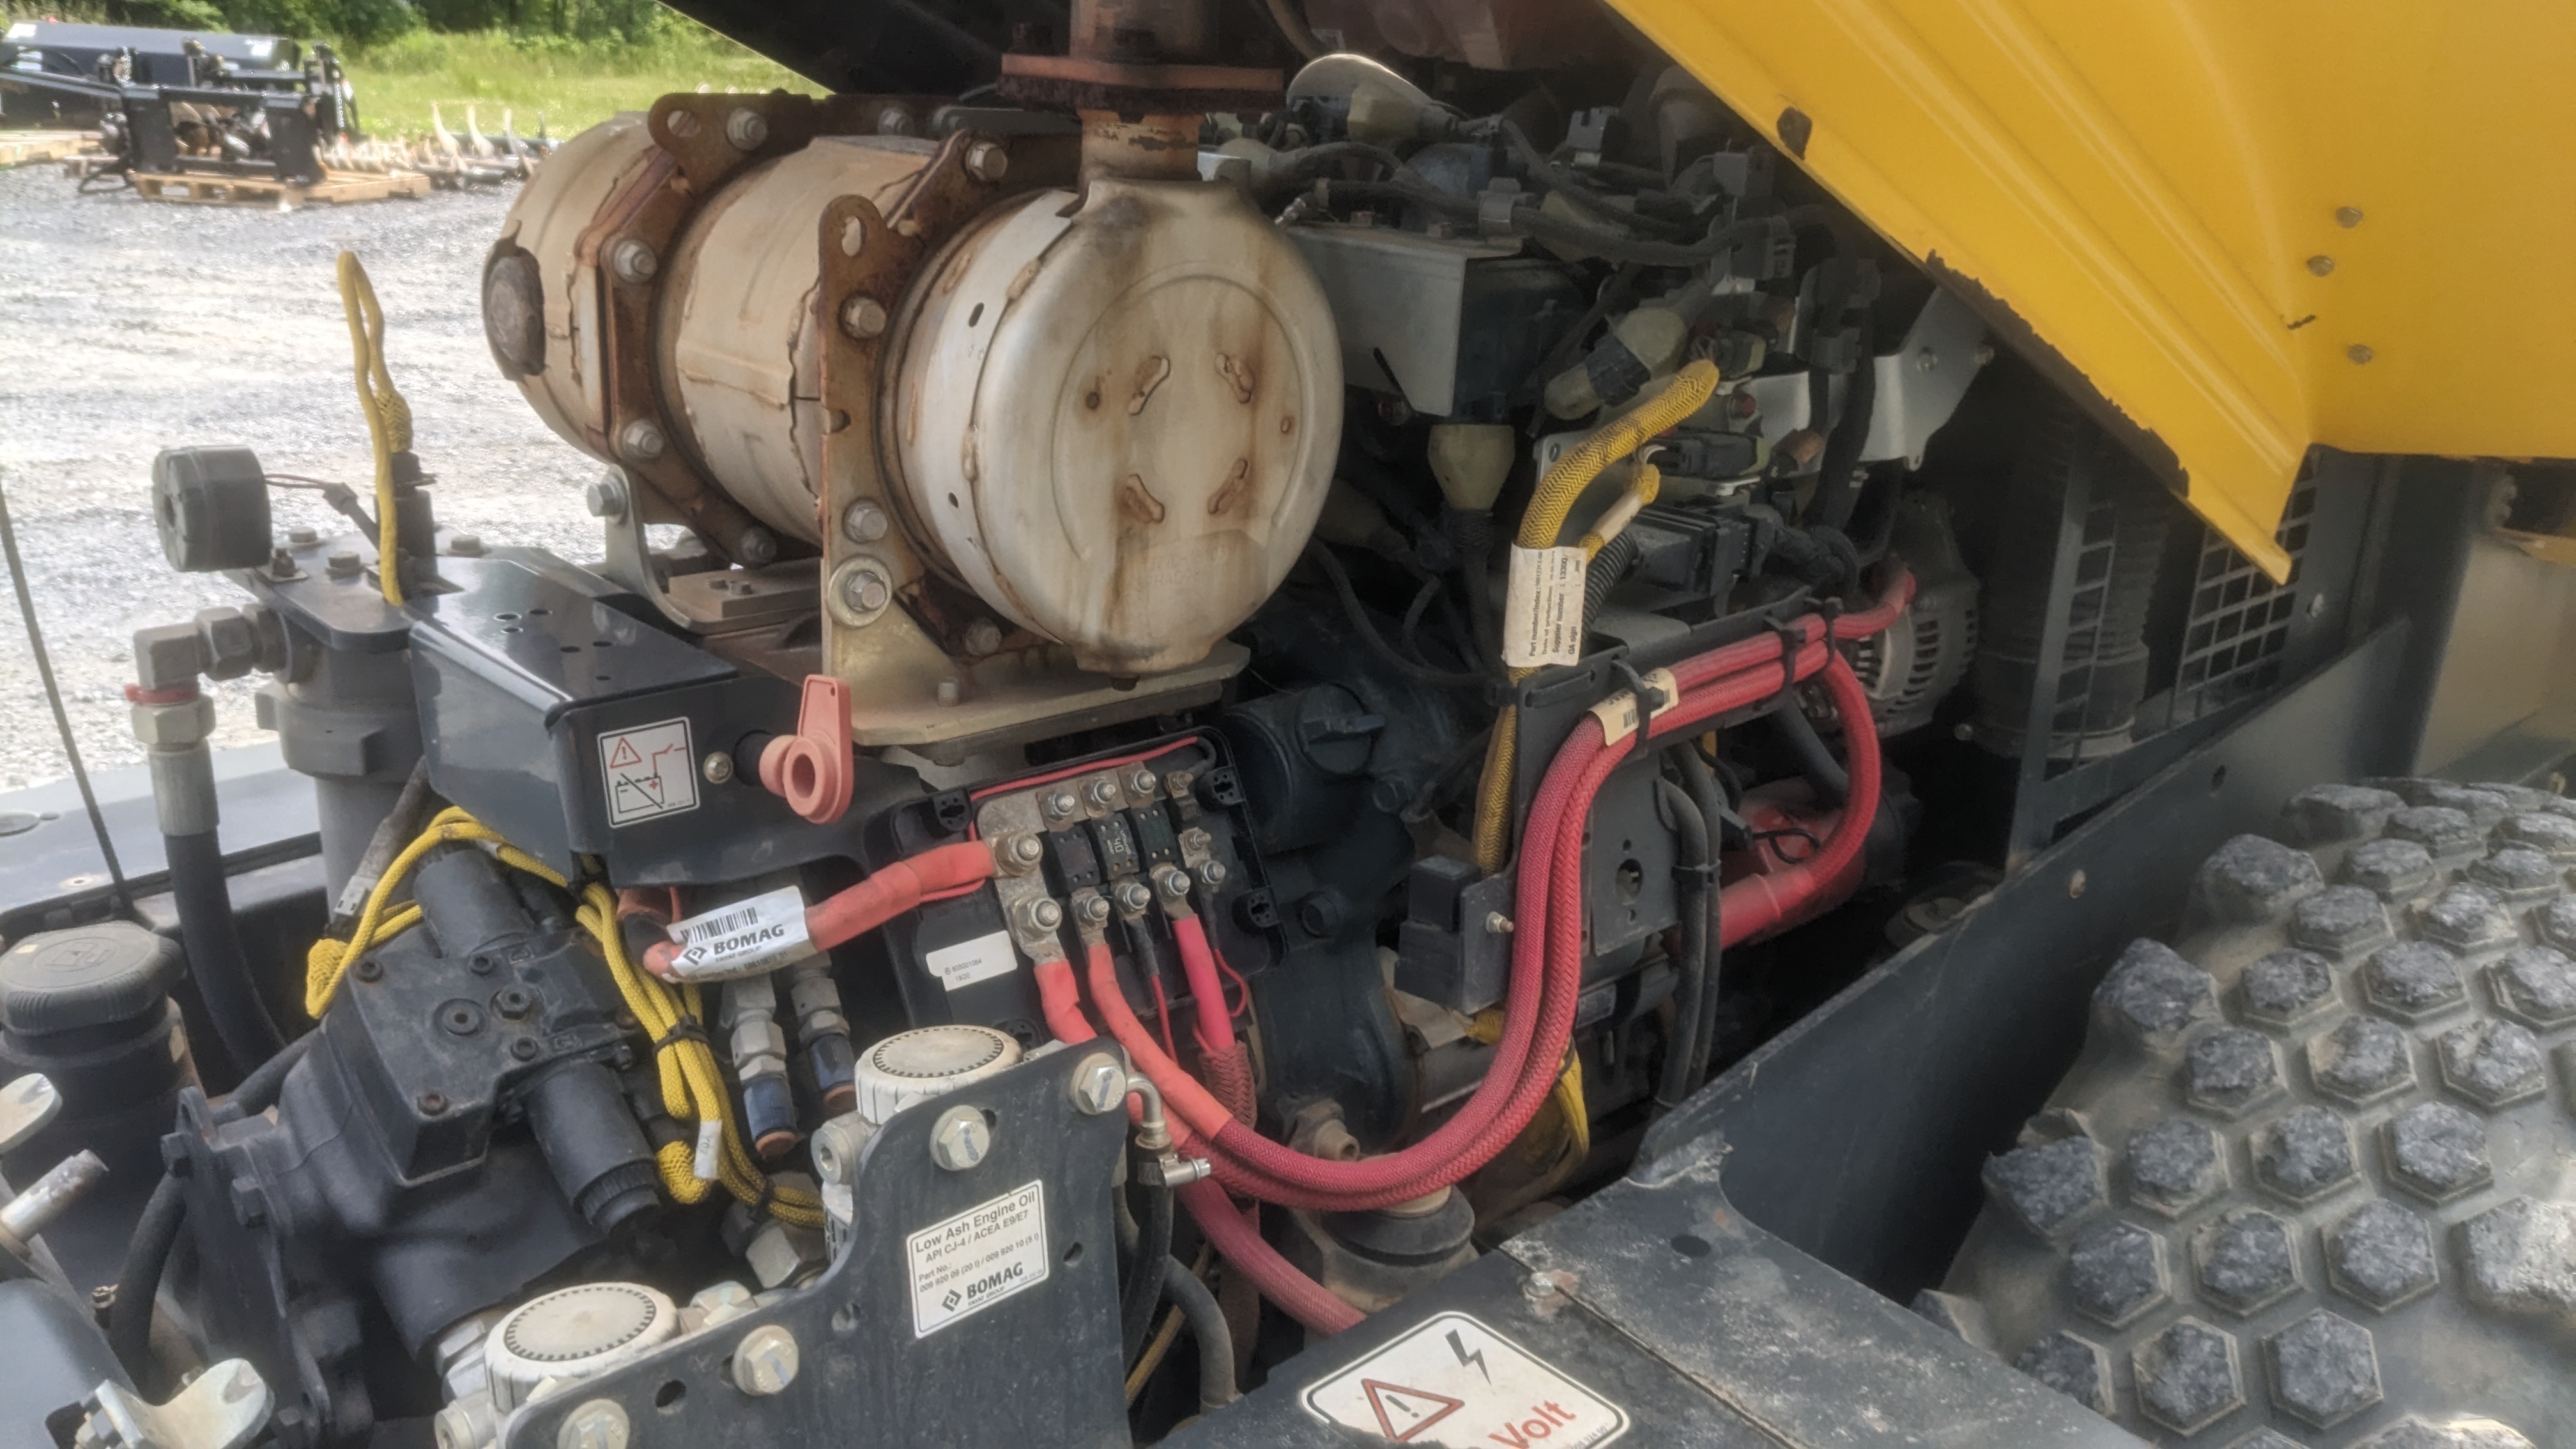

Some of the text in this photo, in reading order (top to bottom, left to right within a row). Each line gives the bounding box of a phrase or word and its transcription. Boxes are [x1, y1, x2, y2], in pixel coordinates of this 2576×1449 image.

[1556, 593, 1564, 621] number
[1552, 624, 1561, 652] Supplier
[1569, 626, 1577, 641] sign
[1568, 644, 1575, 654] QA
[1113, 838, 1124, 853] 40
[714, 924, 785, 954] BOMAG
[738, 946, 762, 957] GROUP
[916, 1191, 1034, 1253] Low Ash Engine Oil
[926, 1248, 942, 1262] API
[945, 1239, 965, 1253] CJ-4
[974, 1223, 1000, 1241] ACEA
[1016, 1239, 1023, 1248] 10
[919, 1269, 934, 1280] Part
[967, 1262, 1023, 1298] BOMAG
[1488, 1400, 1576, 1449] Volt
